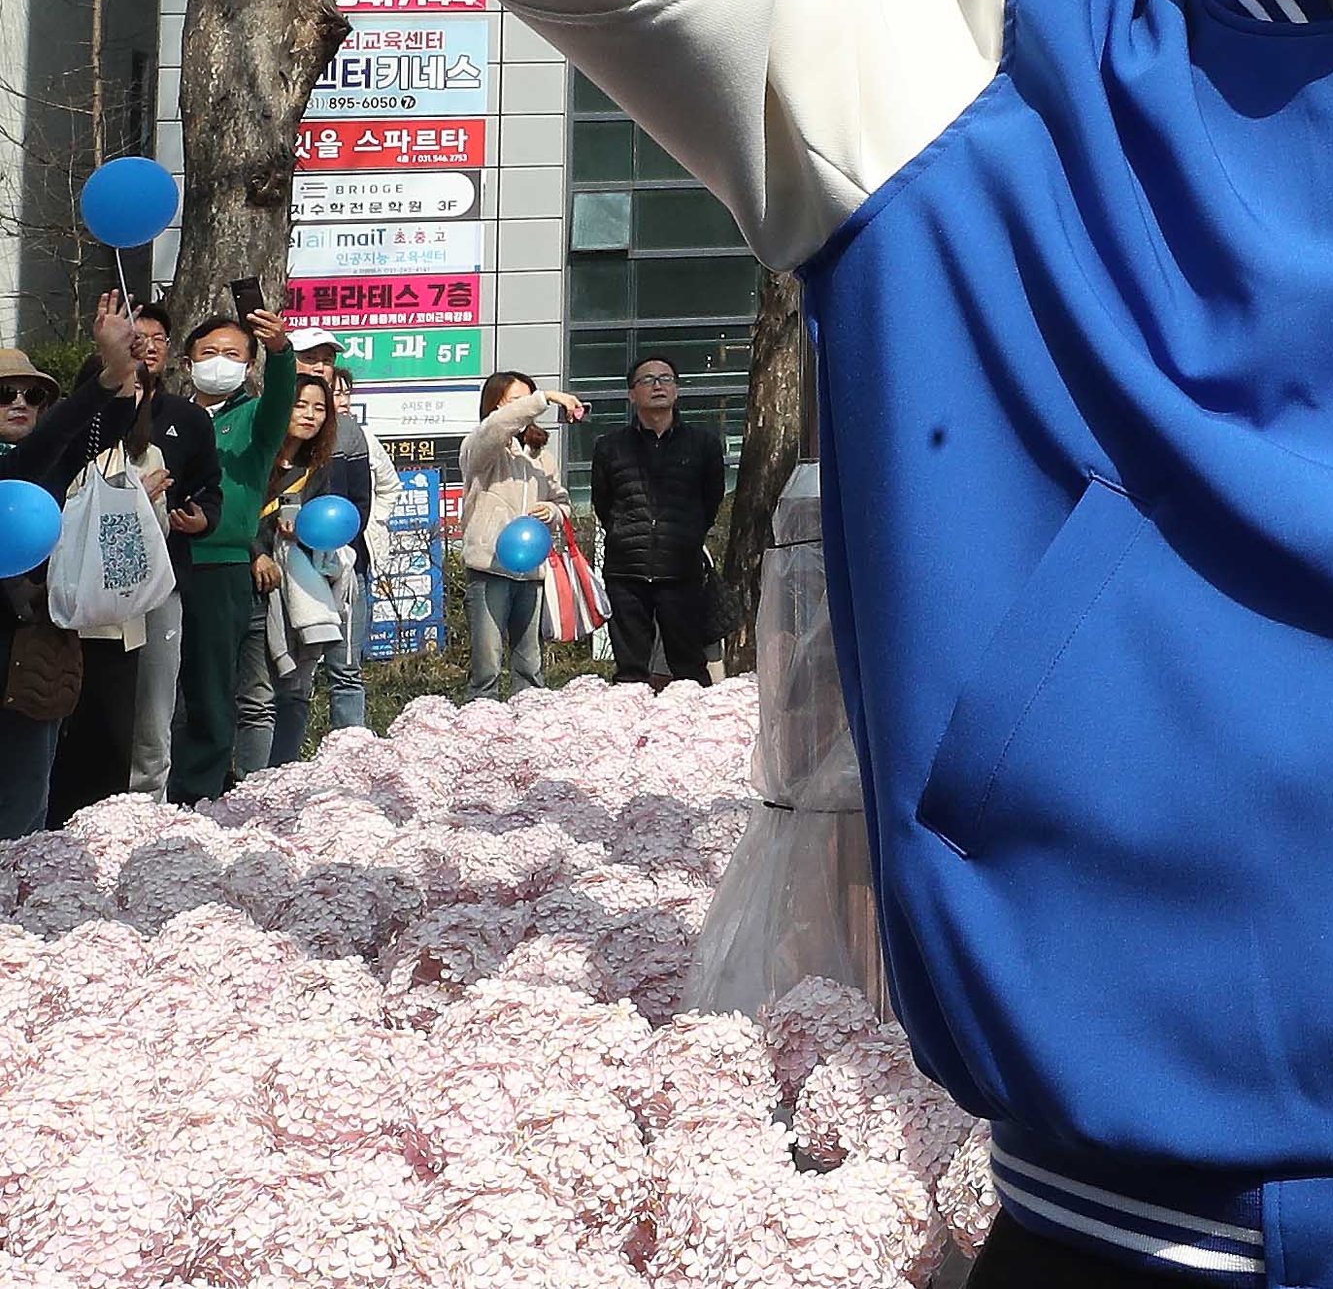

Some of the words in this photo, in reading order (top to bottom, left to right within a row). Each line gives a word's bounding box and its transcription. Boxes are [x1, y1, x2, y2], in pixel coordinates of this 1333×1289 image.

[341, 31, 444, 51] 뇌교육센터
[329, 96, 398, 109] 895-6050
[353, 127, 469, 154] 스파르타
[437, 199, 458, 212] 3F
[336, 251, 389, 266] 인공지능
[313, 283, 420, 311] 필라테스
[427, 282, 472, 308] 7층
[436, 343, 470, 362] 5F
